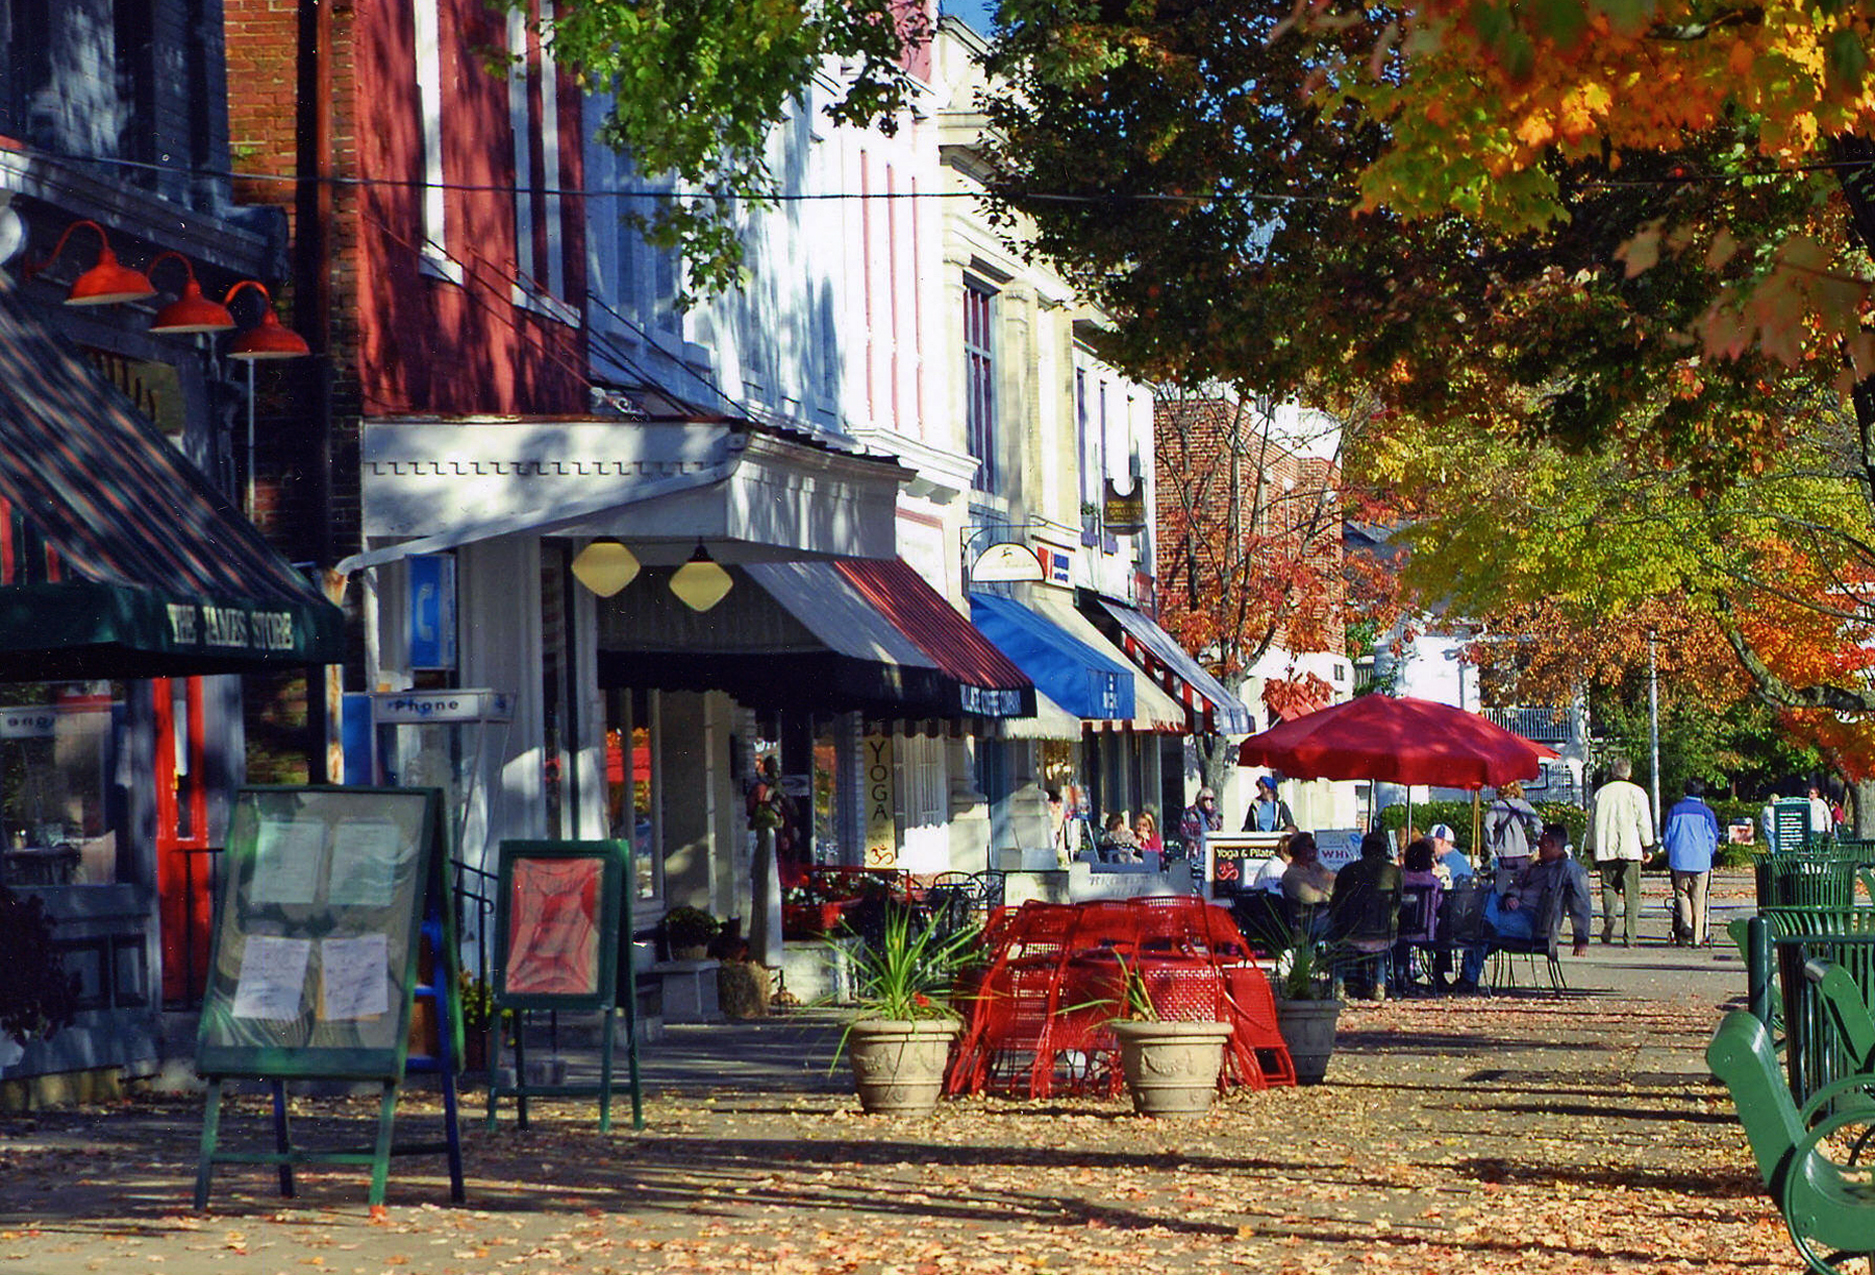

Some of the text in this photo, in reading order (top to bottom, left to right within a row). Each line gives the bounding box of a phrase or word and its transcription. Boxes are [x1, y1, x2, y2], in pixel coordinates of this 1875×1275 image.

[166, 602, 295, 650] THE JAMES STORE
[393, 697, 459, 711] Phone
[869, 741, 888, 821] YOGA
[1216, 848, 1239, 860] Yoga
[1249, 848, 1276, 858] Pilate
